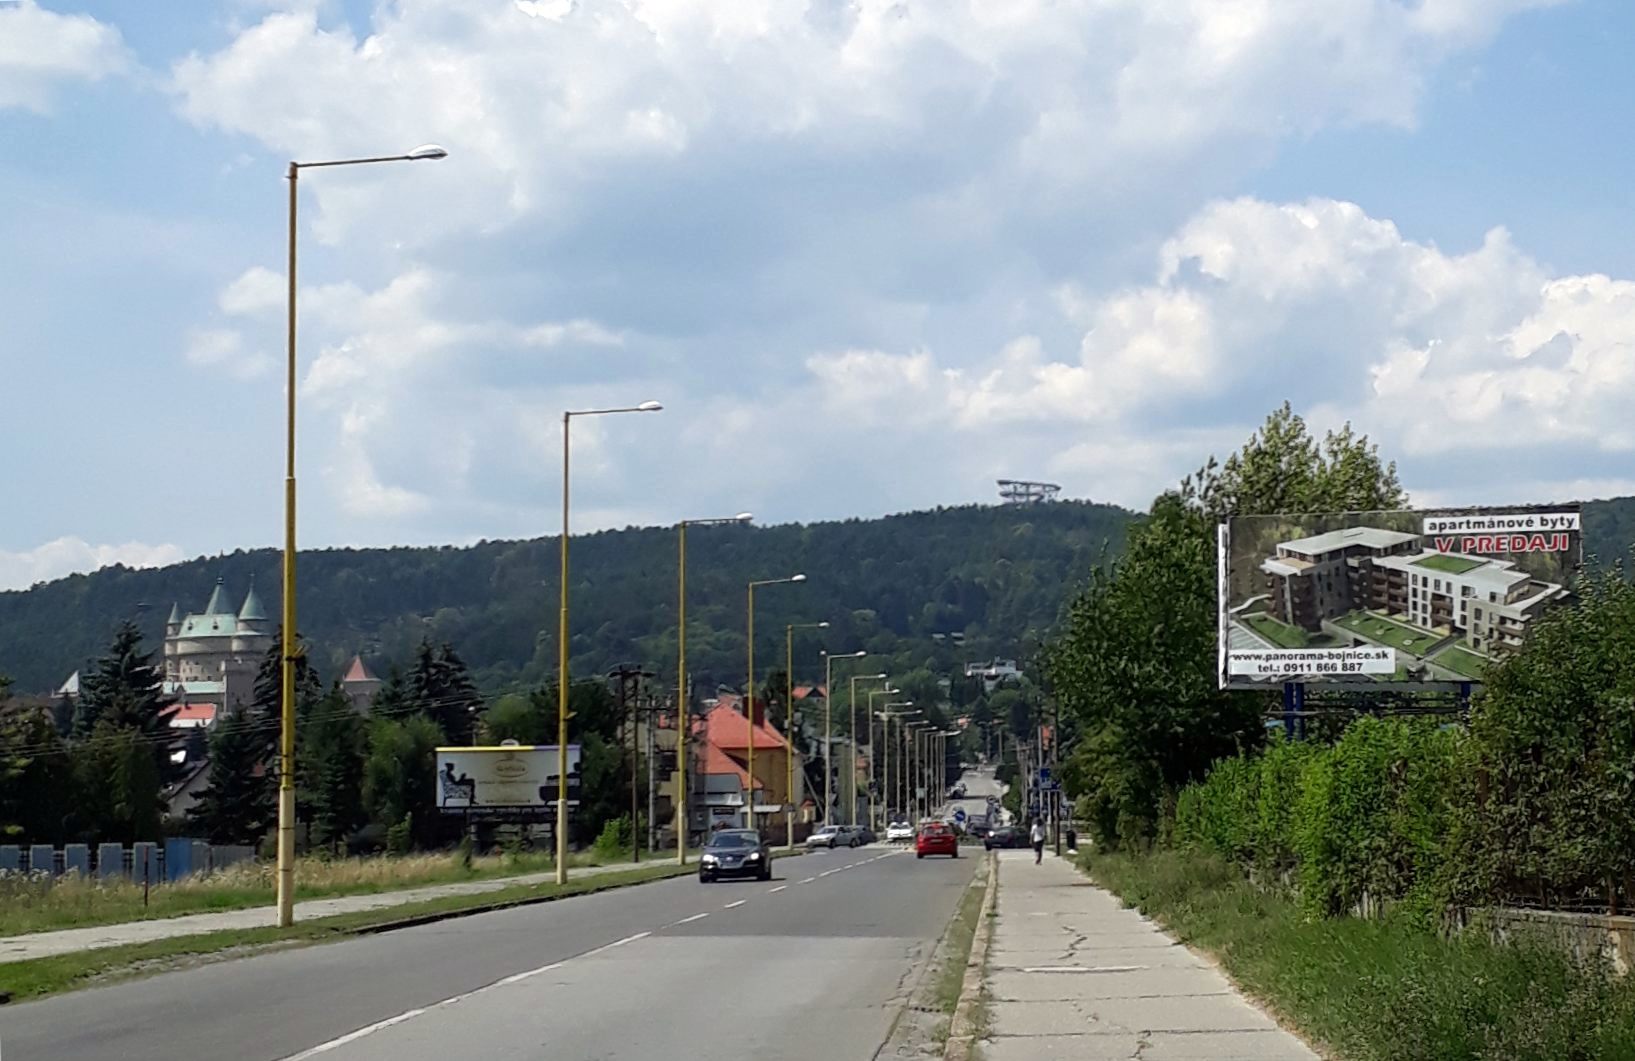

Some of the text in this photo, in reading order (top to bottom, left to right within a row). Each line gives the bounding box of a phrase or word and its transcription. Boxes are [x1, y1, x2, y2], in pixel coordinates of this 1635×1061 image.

[1429, 516, 1575, 532] apartmánové byty
[1435, 533, 1569, 553] V PREDAJI
[1231, 650, 1389, 662] www.panorama-bojnice.sk
[1258, 663, 1363, 673] tel.: 0911 866 887
